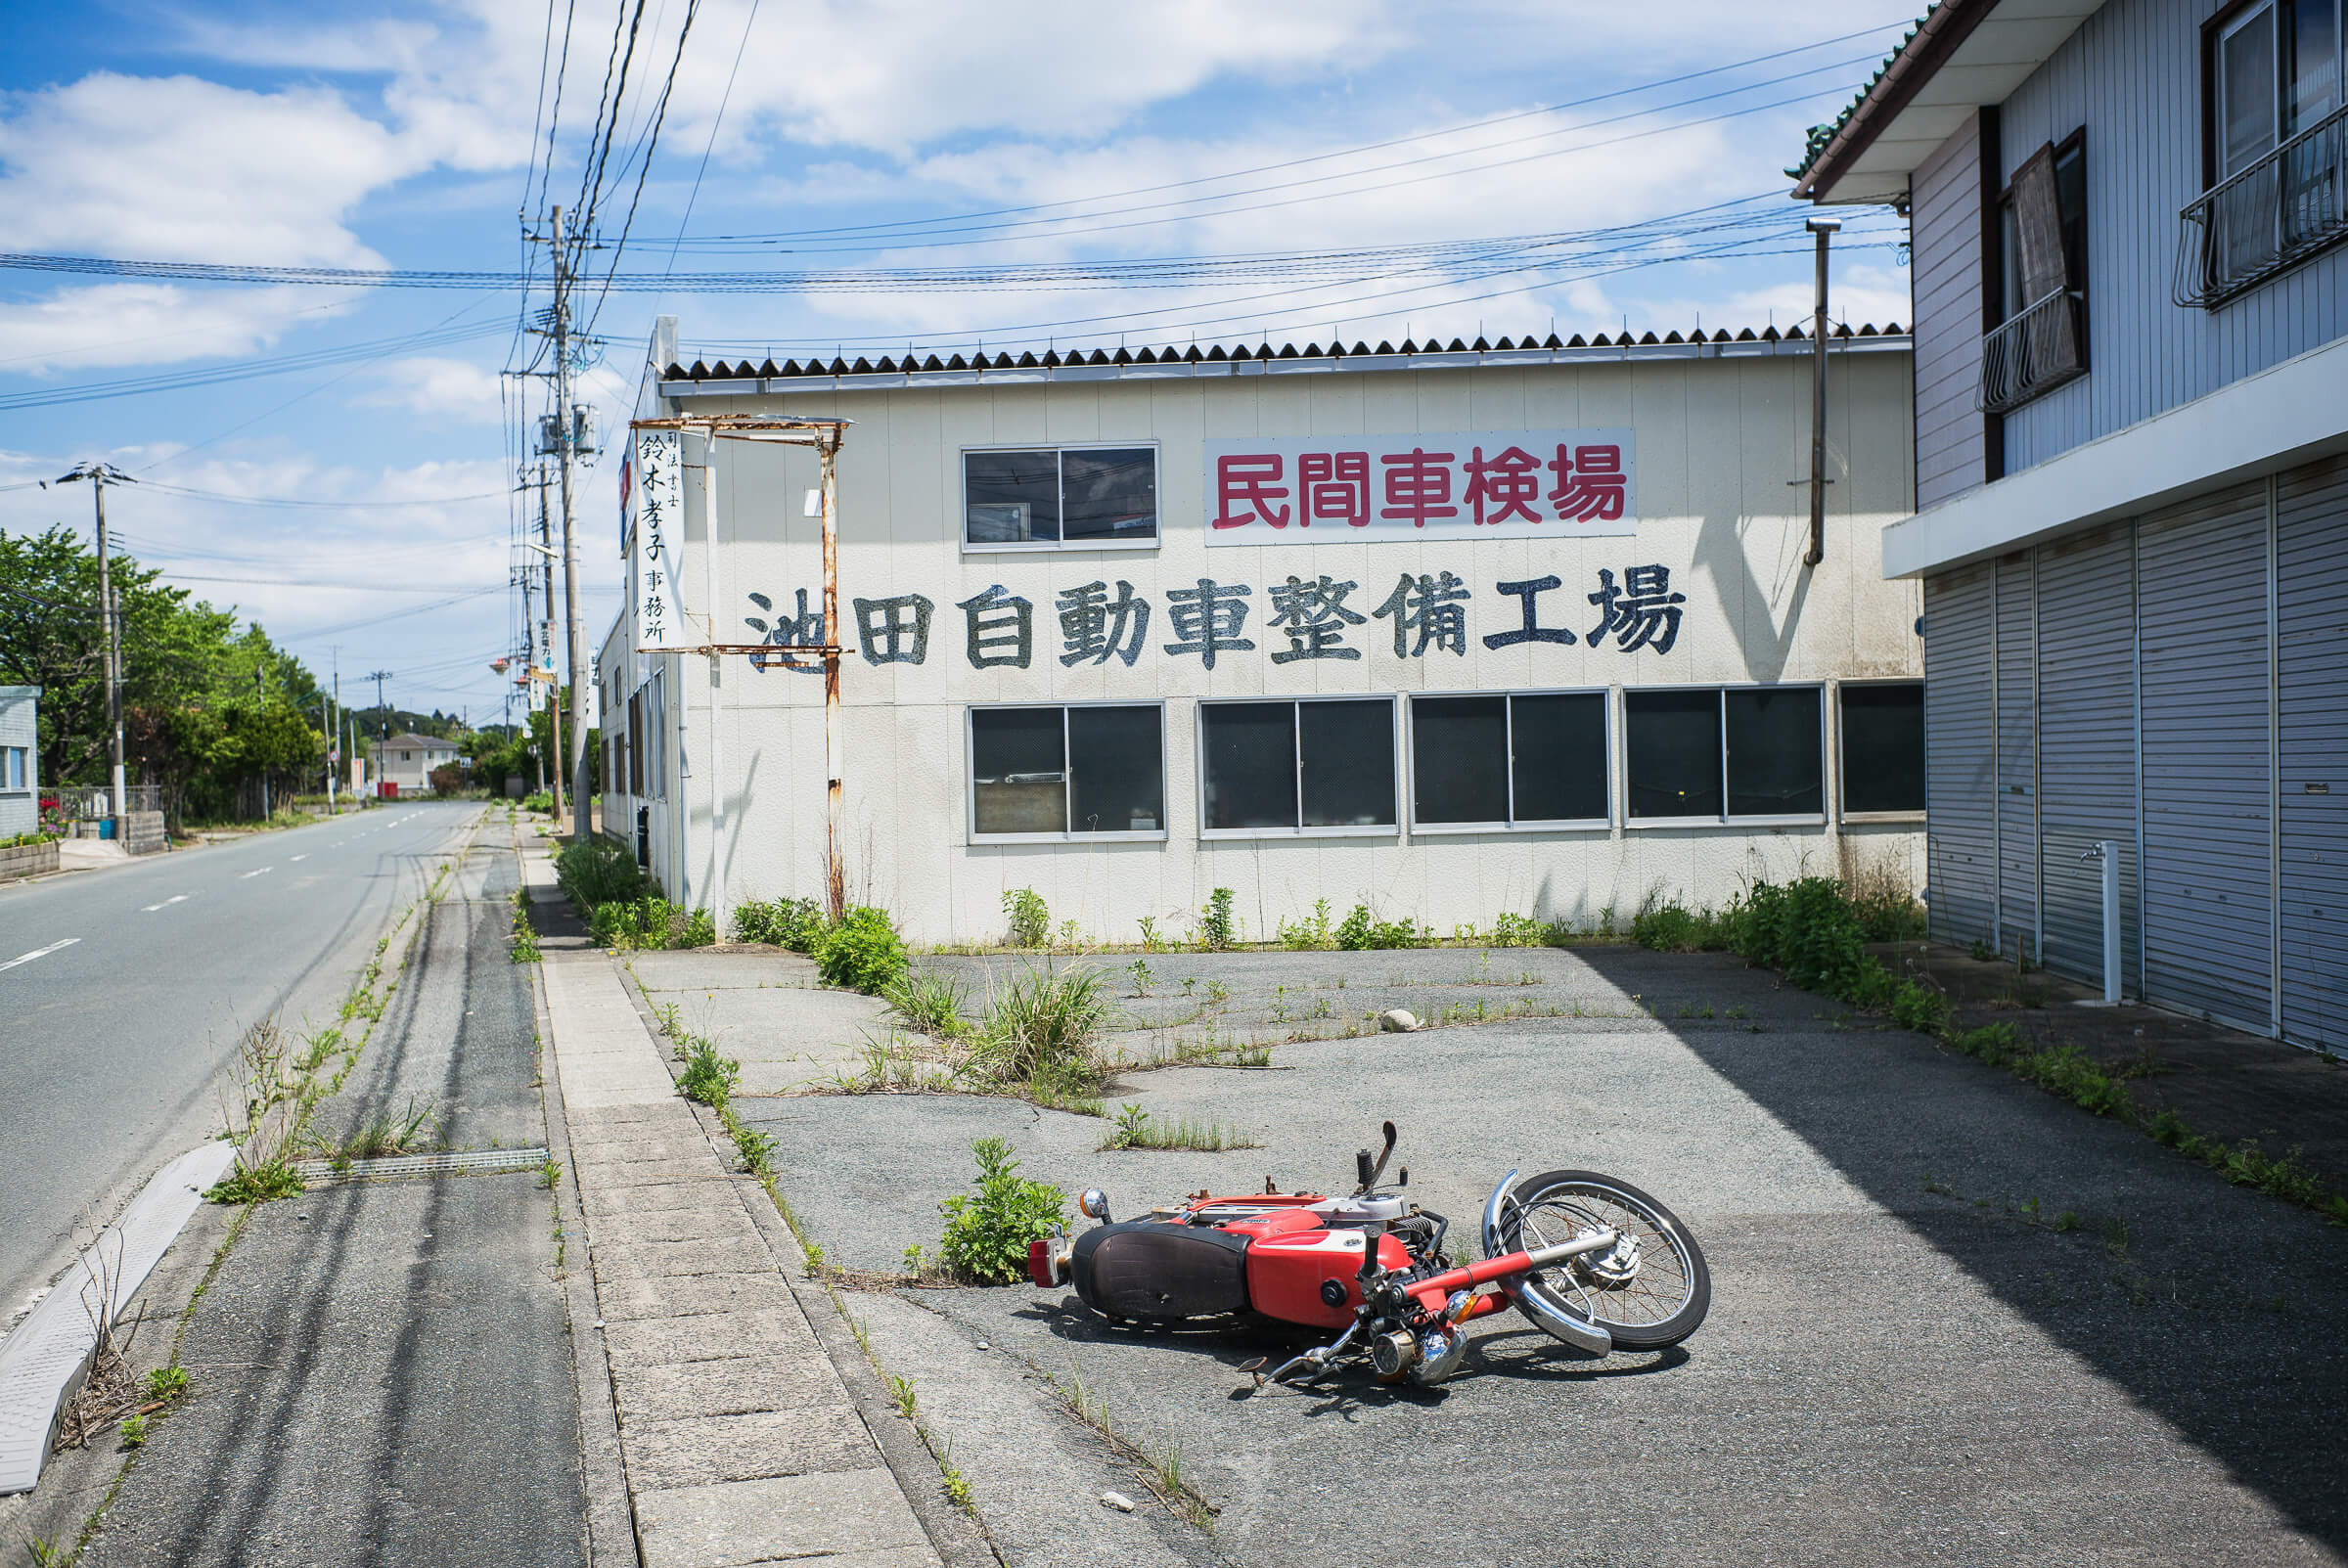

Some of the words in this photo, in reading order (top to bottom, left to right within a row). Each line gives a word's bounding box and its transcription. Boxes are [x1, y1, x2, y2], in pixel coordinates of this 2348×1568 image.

[667, 431, 680, 508] 司法書士
[1212, 443, 1627, 530] 民間車検場
[639, 434, 667, 644] 鈴木孝子事務所
[744, 563, 1688, 675] 池田自動車整備工場
